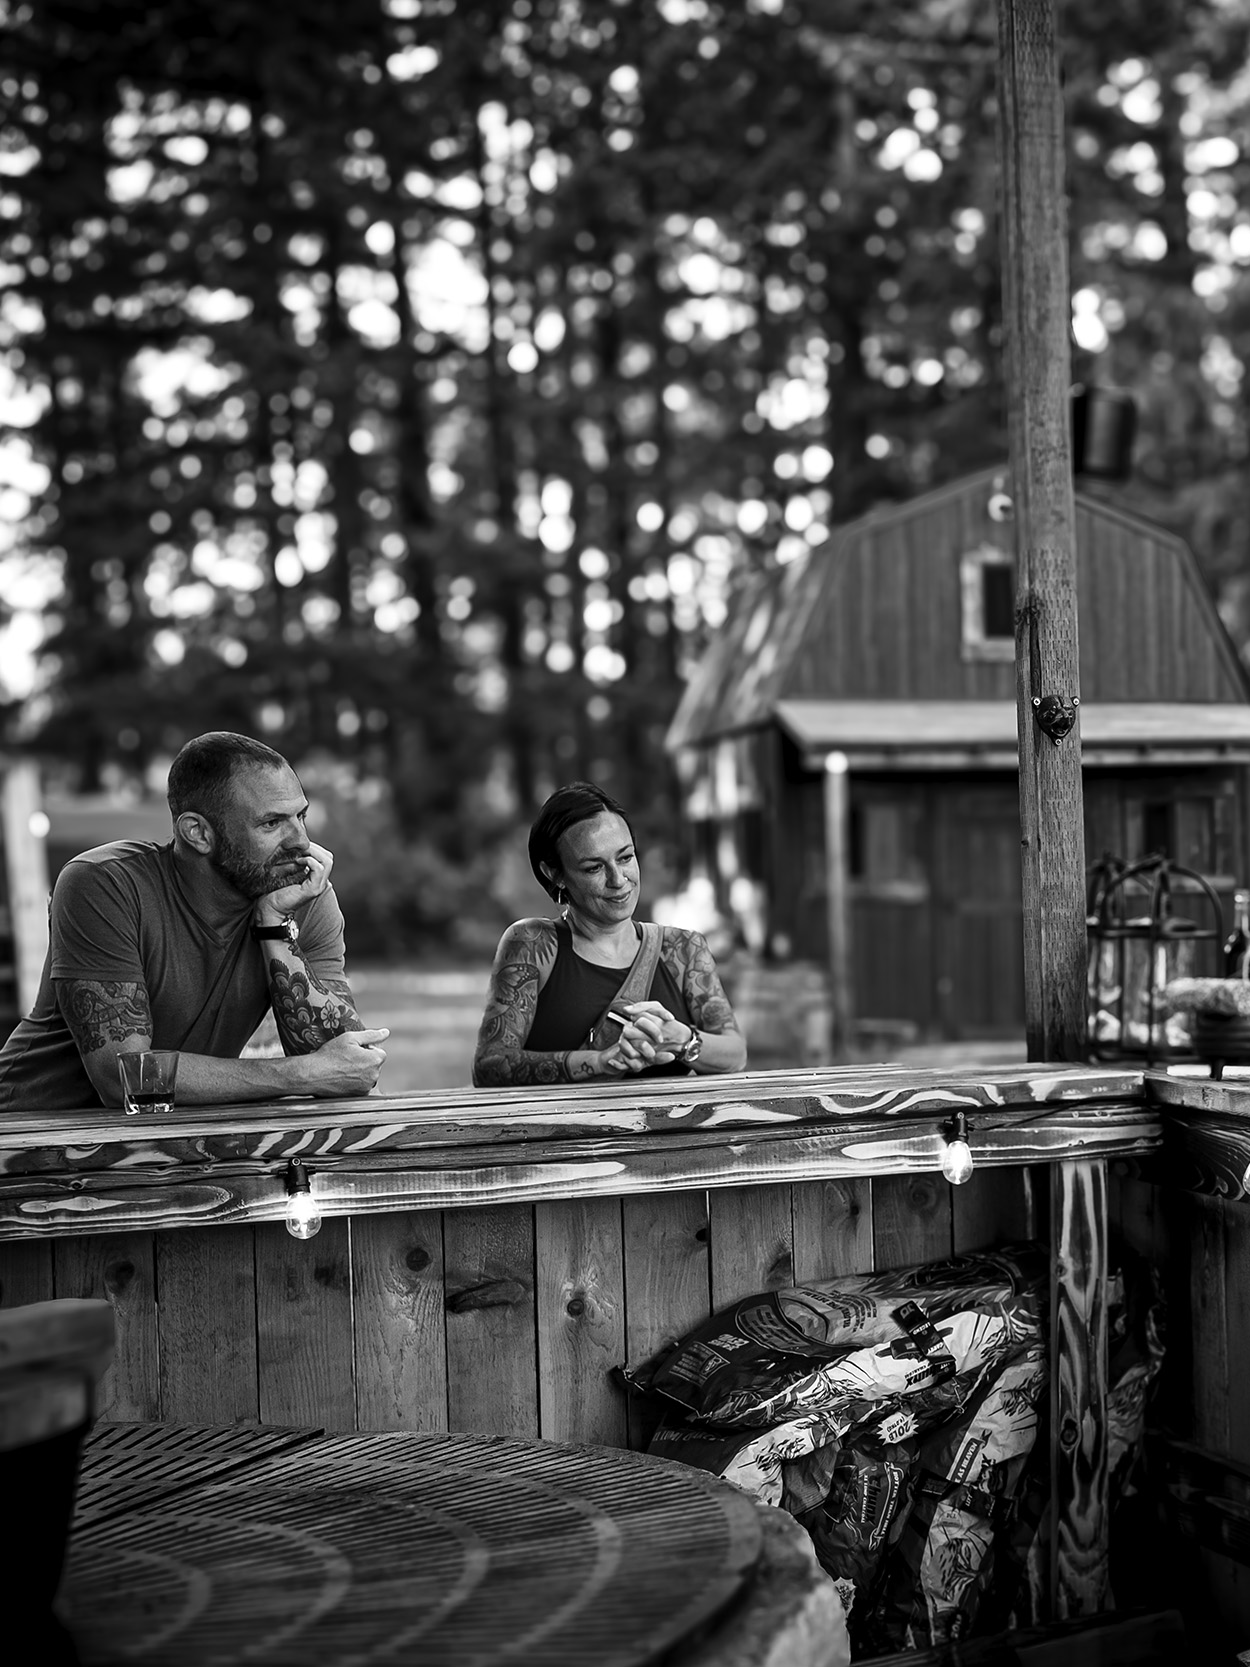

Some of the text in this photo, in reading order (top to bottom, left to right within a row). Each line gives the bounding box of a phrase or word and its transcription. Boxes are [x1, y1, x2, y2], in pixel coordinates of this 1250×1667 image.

[912, 1321, 931, 1336] LEGEND
[927, 1341, 944, 1355] CARRY
[888, 1420, 911, 1441] 20LB
[961, 1442, 978, 1469] HEAVEN
[881, 1471, 900, 1535] HOTTER THAN HELL
